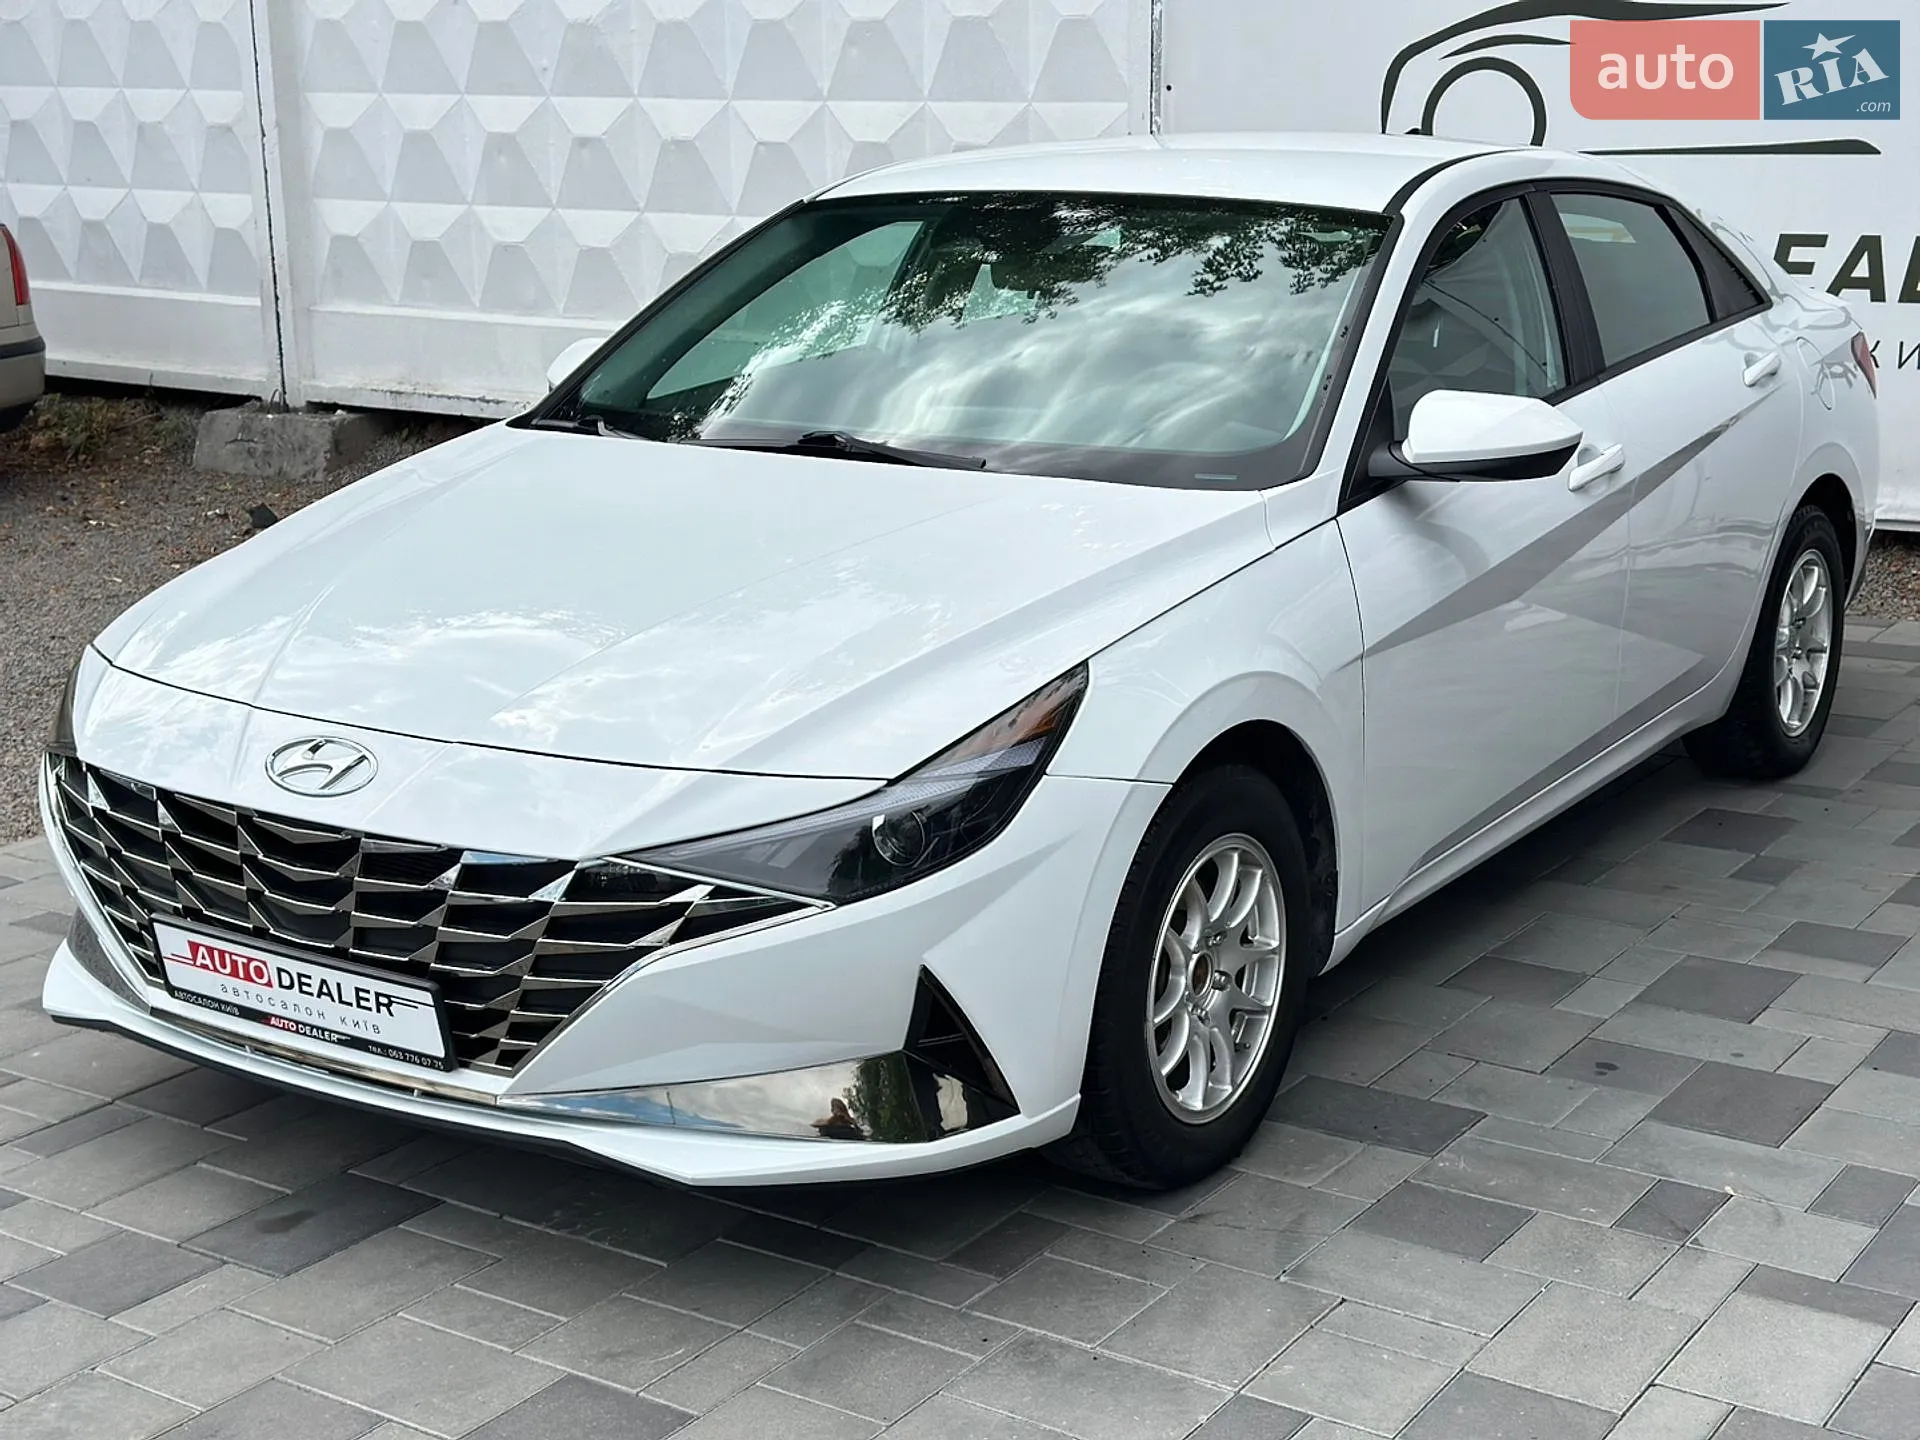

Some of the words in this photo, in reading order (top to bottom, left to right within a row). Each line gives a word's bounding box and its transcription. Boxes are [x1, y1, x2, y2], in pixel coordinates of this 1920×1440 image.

[195, 945, 269, 985] AUTO
[276, 967, 394, 1017] DEALER
[220, 984, 326, 1020] автосалон
[270, 1016, 297, 1031] AUTO
[298, 1024, 338, 1043] DEALER
